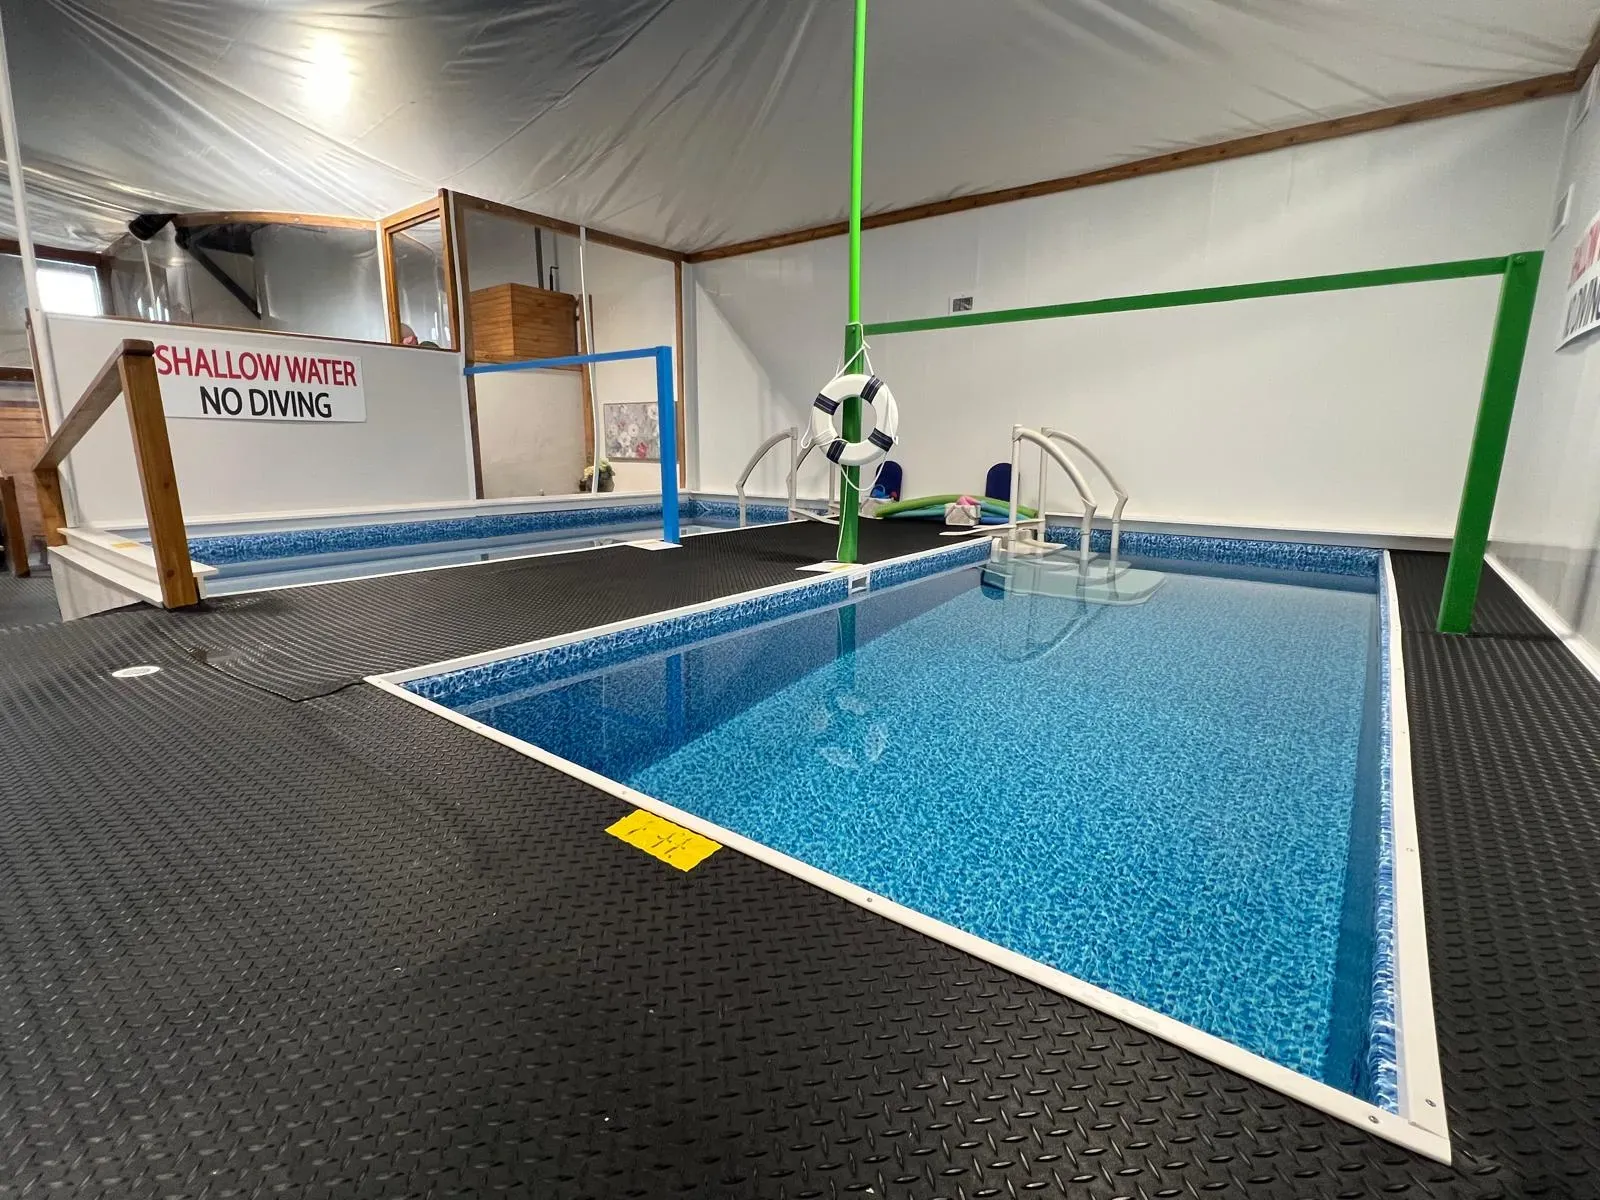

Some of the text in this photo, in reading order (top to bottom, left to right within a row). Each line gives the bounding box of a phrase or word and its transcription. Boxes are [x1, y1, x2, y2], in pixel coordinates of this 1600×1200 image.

[154, 345, 358, 387] SHALLOW WATER
[200, 386, 332, 418] NO DIVING
